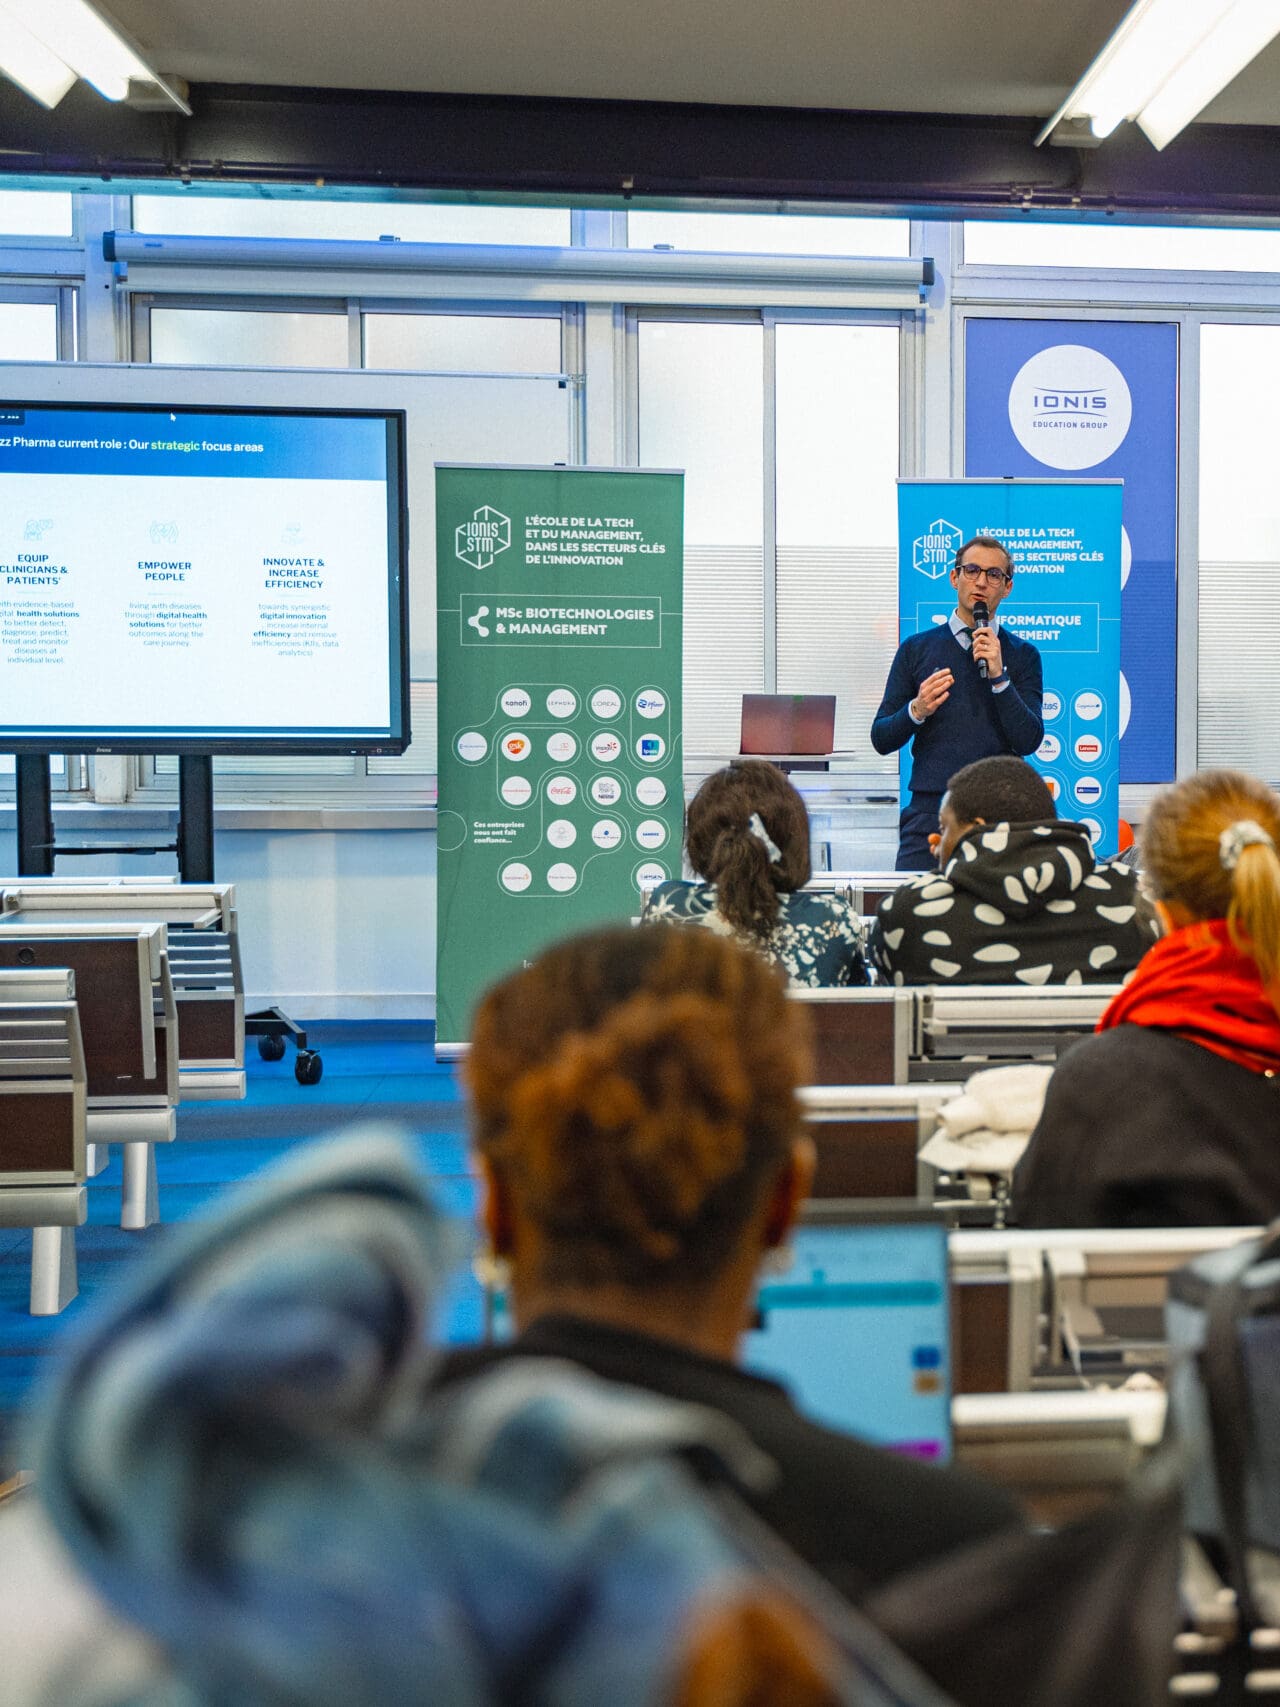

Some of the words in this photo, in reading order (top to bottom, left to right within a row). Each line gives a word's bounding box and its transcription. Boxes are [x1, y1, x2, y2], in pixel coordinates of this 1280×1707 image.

[1034, 395, 1107, 409] IONIS
[1032, 421, 1078, 429] EDUCATION
[13, 437, 56, 448] Pharma
[58, 439, 99, 449] current
[100, 439, 122, 449] role
[129, 440, 150, 450] Our
[151, 441, 200, 453] strategic
[202, 441, 232, 452] focus
[233, 443, 264, 453] areas
[525, 514, 568, 526] L'ÉCOLE
[570, 518, 585, 527] DE
[587, 518, 602, 527] LA
[604, 518, 634, 528] TECH
[467, 522, 498, 537] IONIS
[976, 526, 1015, 537] L'ÉCOLE
[1017, 528, 1031, 537] DE
[1032, 528, 1046, 537] LA
[1048, 528, 1075, 537] TECH
[525, 529, 540, 539] ET
[541, 530, 558, 539] DU
[560, 530, 644, 542] MANAGEMENT,
[467, 537, 494, 552] STM
[923, 534, 952, 549] IONIS
[1008, 540, 1084, 551] MANAGEMENT,
[525, 542, 558, 552] DANS
[560, 543, 579, 552] LES
[581, 543, 637, 554] SECTEURS
[639, 542, 666, 554] CLÉS
[18, 554, 49, 563] EQUIP
[525, 555, 541, 564] DE
[543, 555, 624, 566] L'INNOVATION
[923, 549, 947, 563] STM
[1013, 552, 1025, 561] ES
[1027, 552, 1077, 562] SECTEURS
[1079, 550, 1104, 562] CLÉS
[138, 562, 192, 570] EMPOWER
[263, 558, 315, 566] INNOVATE
[317, 559, 325, 567] &
[0, 565, 58, 574] CLINICIANS
[60, 566, 68, 574] &
[269, 569, 319, 577] INCREASE
[145, 573, 185, 581] PEOPLE
[265, 580, 323, 588] EFFICIENCY
[156, 612, 181, 620] digital
[496, 608, 522, 618] MSc
[526, 608, 655, 620] BIOTECHNOLOGIES
[997, 615, 1081, 627] FORMATIQUE
[496, 623, 506, 634] &
[509, 623, 608, 635] MANAGEMENT
[253, 631, 291, 639] efficiency
[487, 821, 525, 829] entreprises
